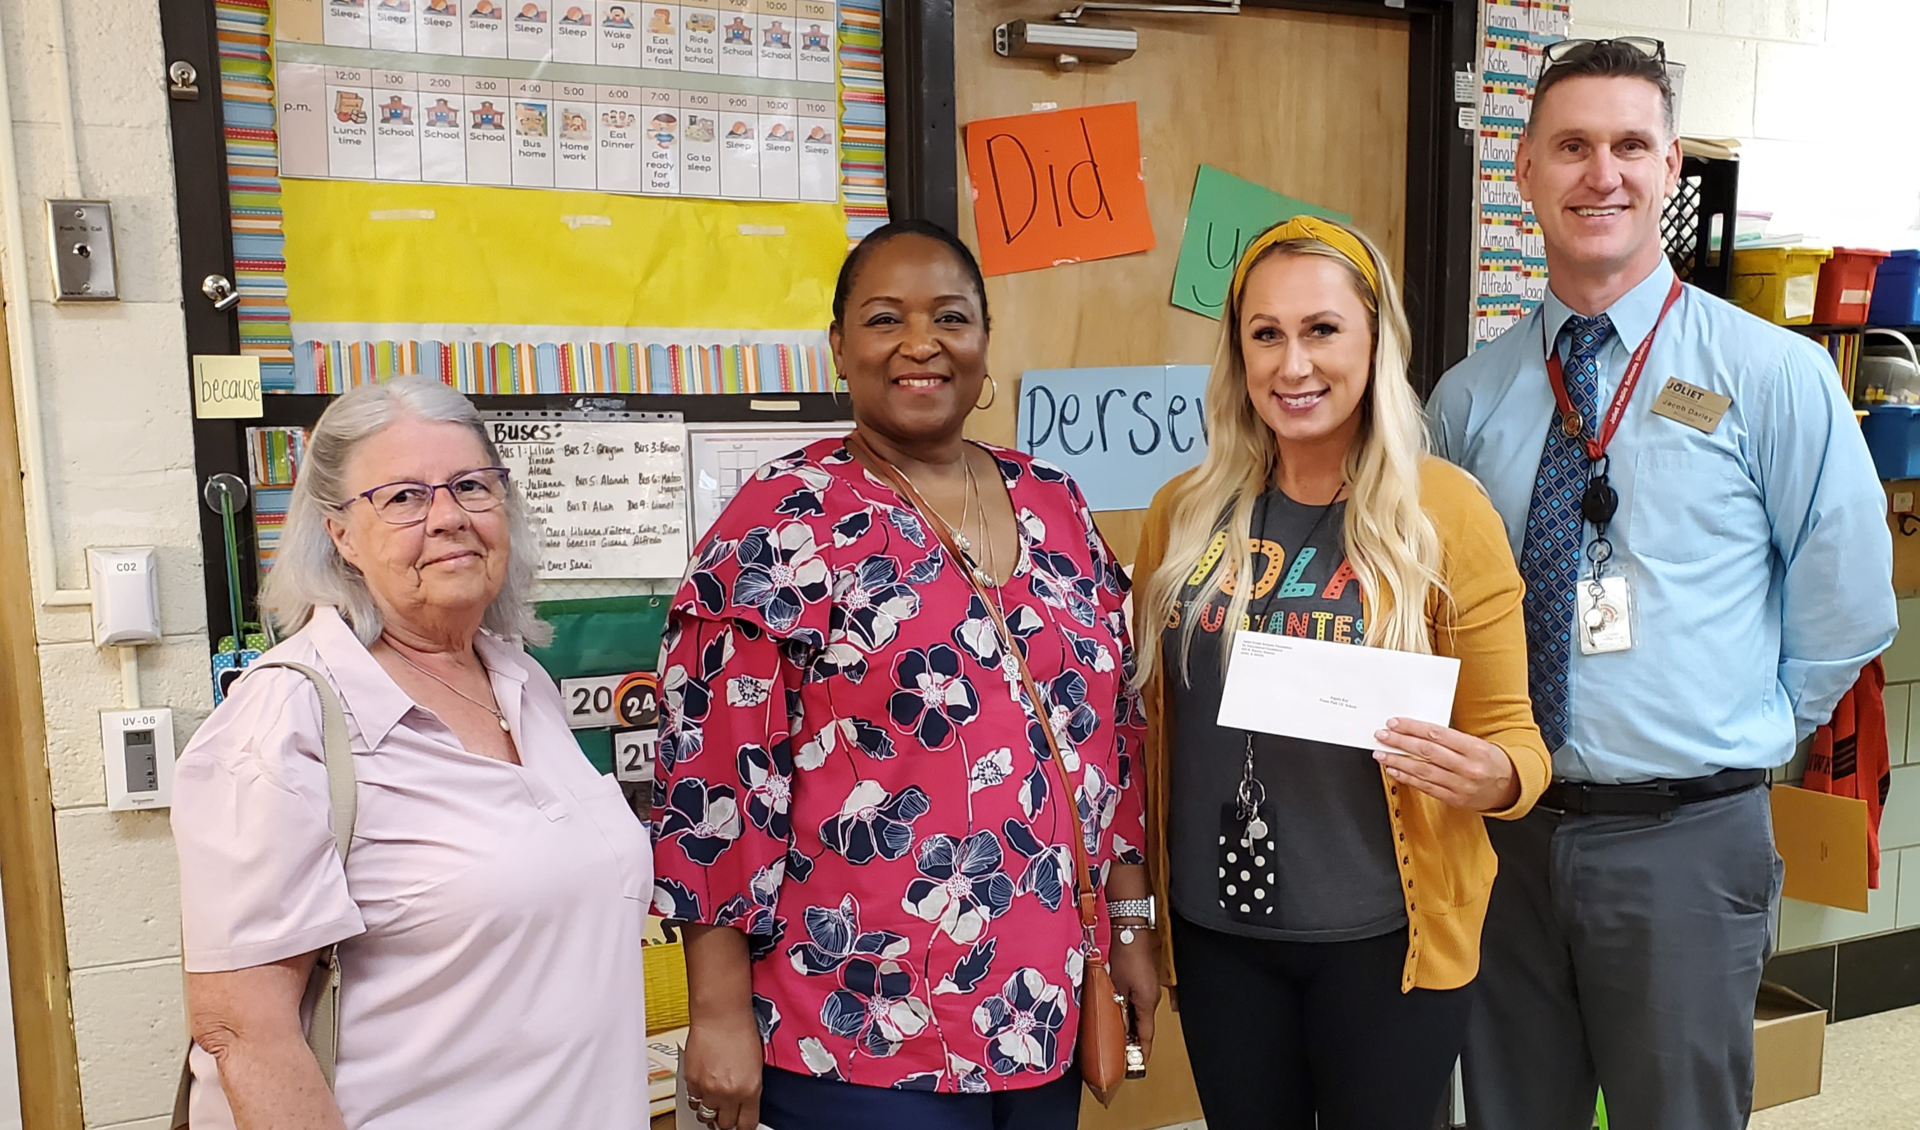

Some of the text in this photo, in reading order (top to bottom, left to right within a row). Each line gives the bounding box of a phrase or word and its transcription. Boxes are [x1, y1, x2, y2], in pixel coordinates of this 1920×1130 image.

[766, 2, 787, 11] 10:00
[805, 5, 824, 14] 11:00
[330, 8, 360, 20] Sleep
[378, 12, 406, 24] Sleep
[424, 18, 452, 28] Sleep
[469, 20, 498, 31] Sleep
[514, 24, 543, 34] Sleep
[558, 27, 587, 38] Sleep
[604, 30, 632, 40] Wake
[690, 35, 708, 44] Ride
[612, 40, 625, 50] up
[652, 36, 669, 45] Eat
[646, 46, 674, 56] Break
[685, 45, 713, 54] bus to
[723, 47, 752, 57] School
[684, 54, 714, 64] school
[761, 50, 792, 60] School
[800, 54, 830, 63] School
[654, 56, 672, 65] fast
[335, 71, 361, 81] 12:00
[384, 74, 403, 84] 1:00
[430, 78, 450, 88] 2:00
[476, 81, 496, 90] 3:00
[520, 84, 540, 93] 4:00
[564, 87, 584, 96] 5:00
[608, 90, 628, 98] 6:00
[651, 92, 670, 102] 7:00
[690, 96, 708, 104] 8:00
[729, 98, 747, 108] 9:00
[284, 102, 312, 113] p.m.
[766, 101, 788, 110] 10:00
[806, 104, 825, 112] 11:00
[333, 126, 366, 136] Lunch
[378, 127, 414, 137] School
[424, 130, 460, 140] School
[610, 130, 626, 140] Eat
[338, 136, 362, 146] time
[470, 132, 506, 142] School
[523, 139, 541, 148] Bus
[560, 142, 589, 152] Home
[601, 140, 634, 150] Dinner
[726, 140, 752, 151] Sleep
[766, 143, 791, 153] Sleep
[518, 149, 546, 158] home
[805, 145, 828, 155] Sleep
[562, 152, 586, 161] work
[652, 151, 668, 160] Get
[687, 154, 712, 162] Go to
[646, 162, 674, 172] ready
[688, 163, 712, 173] sleep
[654, 171, 668, 180] for
[986, 116, 1114, 245] Did
[651, 180, 670, 188] bed
[1482, 182, 1519, 204] Matthew
[1484, 225, 1515, 248] Ximena
[1481, 272, 1512, 294] Alfredo
[200, 362, 260, 403] because
[1662, 400, 1686, 412] Jacob
[1688, 408, 1714, 423] Darley
[494, 422, 562, 443] Buses:
[564, 444, 580, 457] Bus
[634, 441, 650, 454] Bus
[572, 686, 612, 716] 20
[626, 693, 656, 718] 24
[122, 716, 156, 727] UV-06
